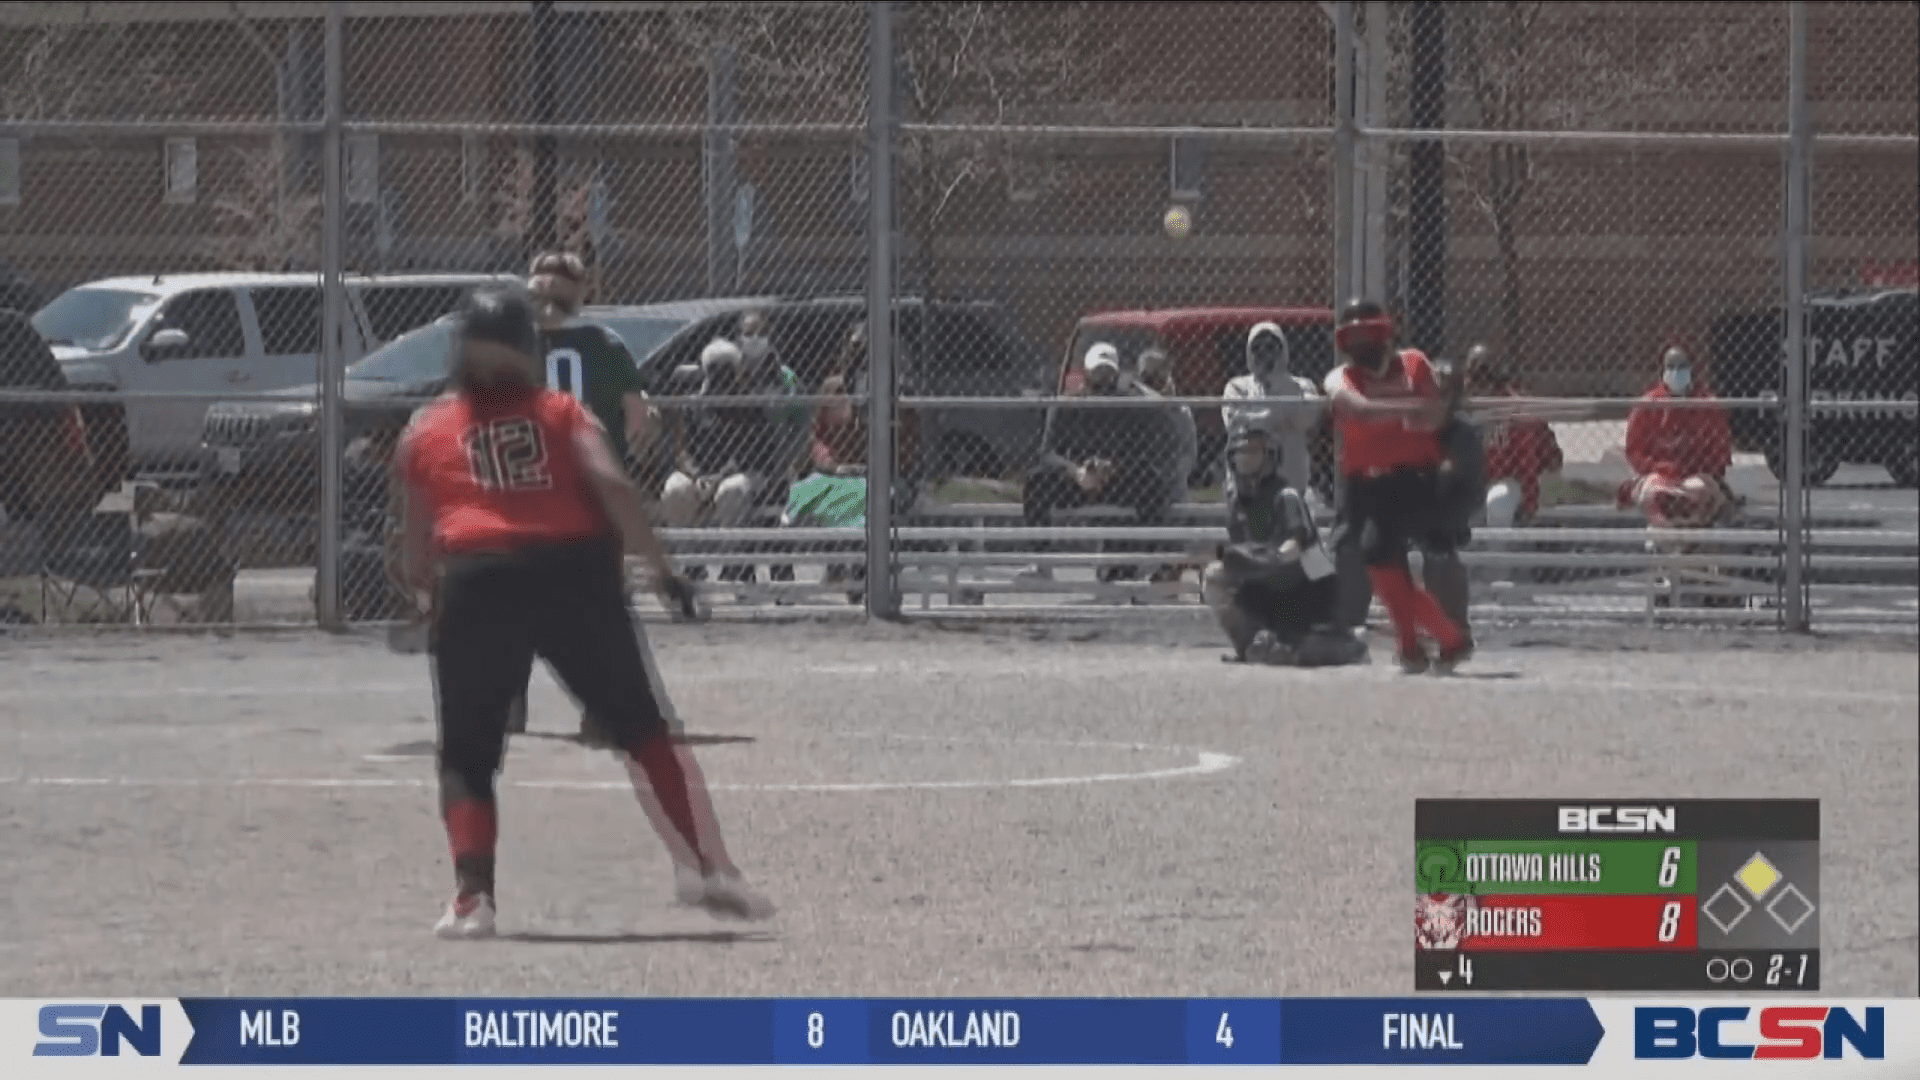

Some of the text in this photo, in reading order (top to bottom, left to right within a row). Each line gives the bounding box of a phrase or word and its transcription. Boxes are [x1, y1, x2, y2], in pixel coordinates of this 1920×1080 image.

[1782, 337, 1898, 369] TAFF
[1758, 389, 1919, 419] PRKING
[467, 415, 552, 492] 12
